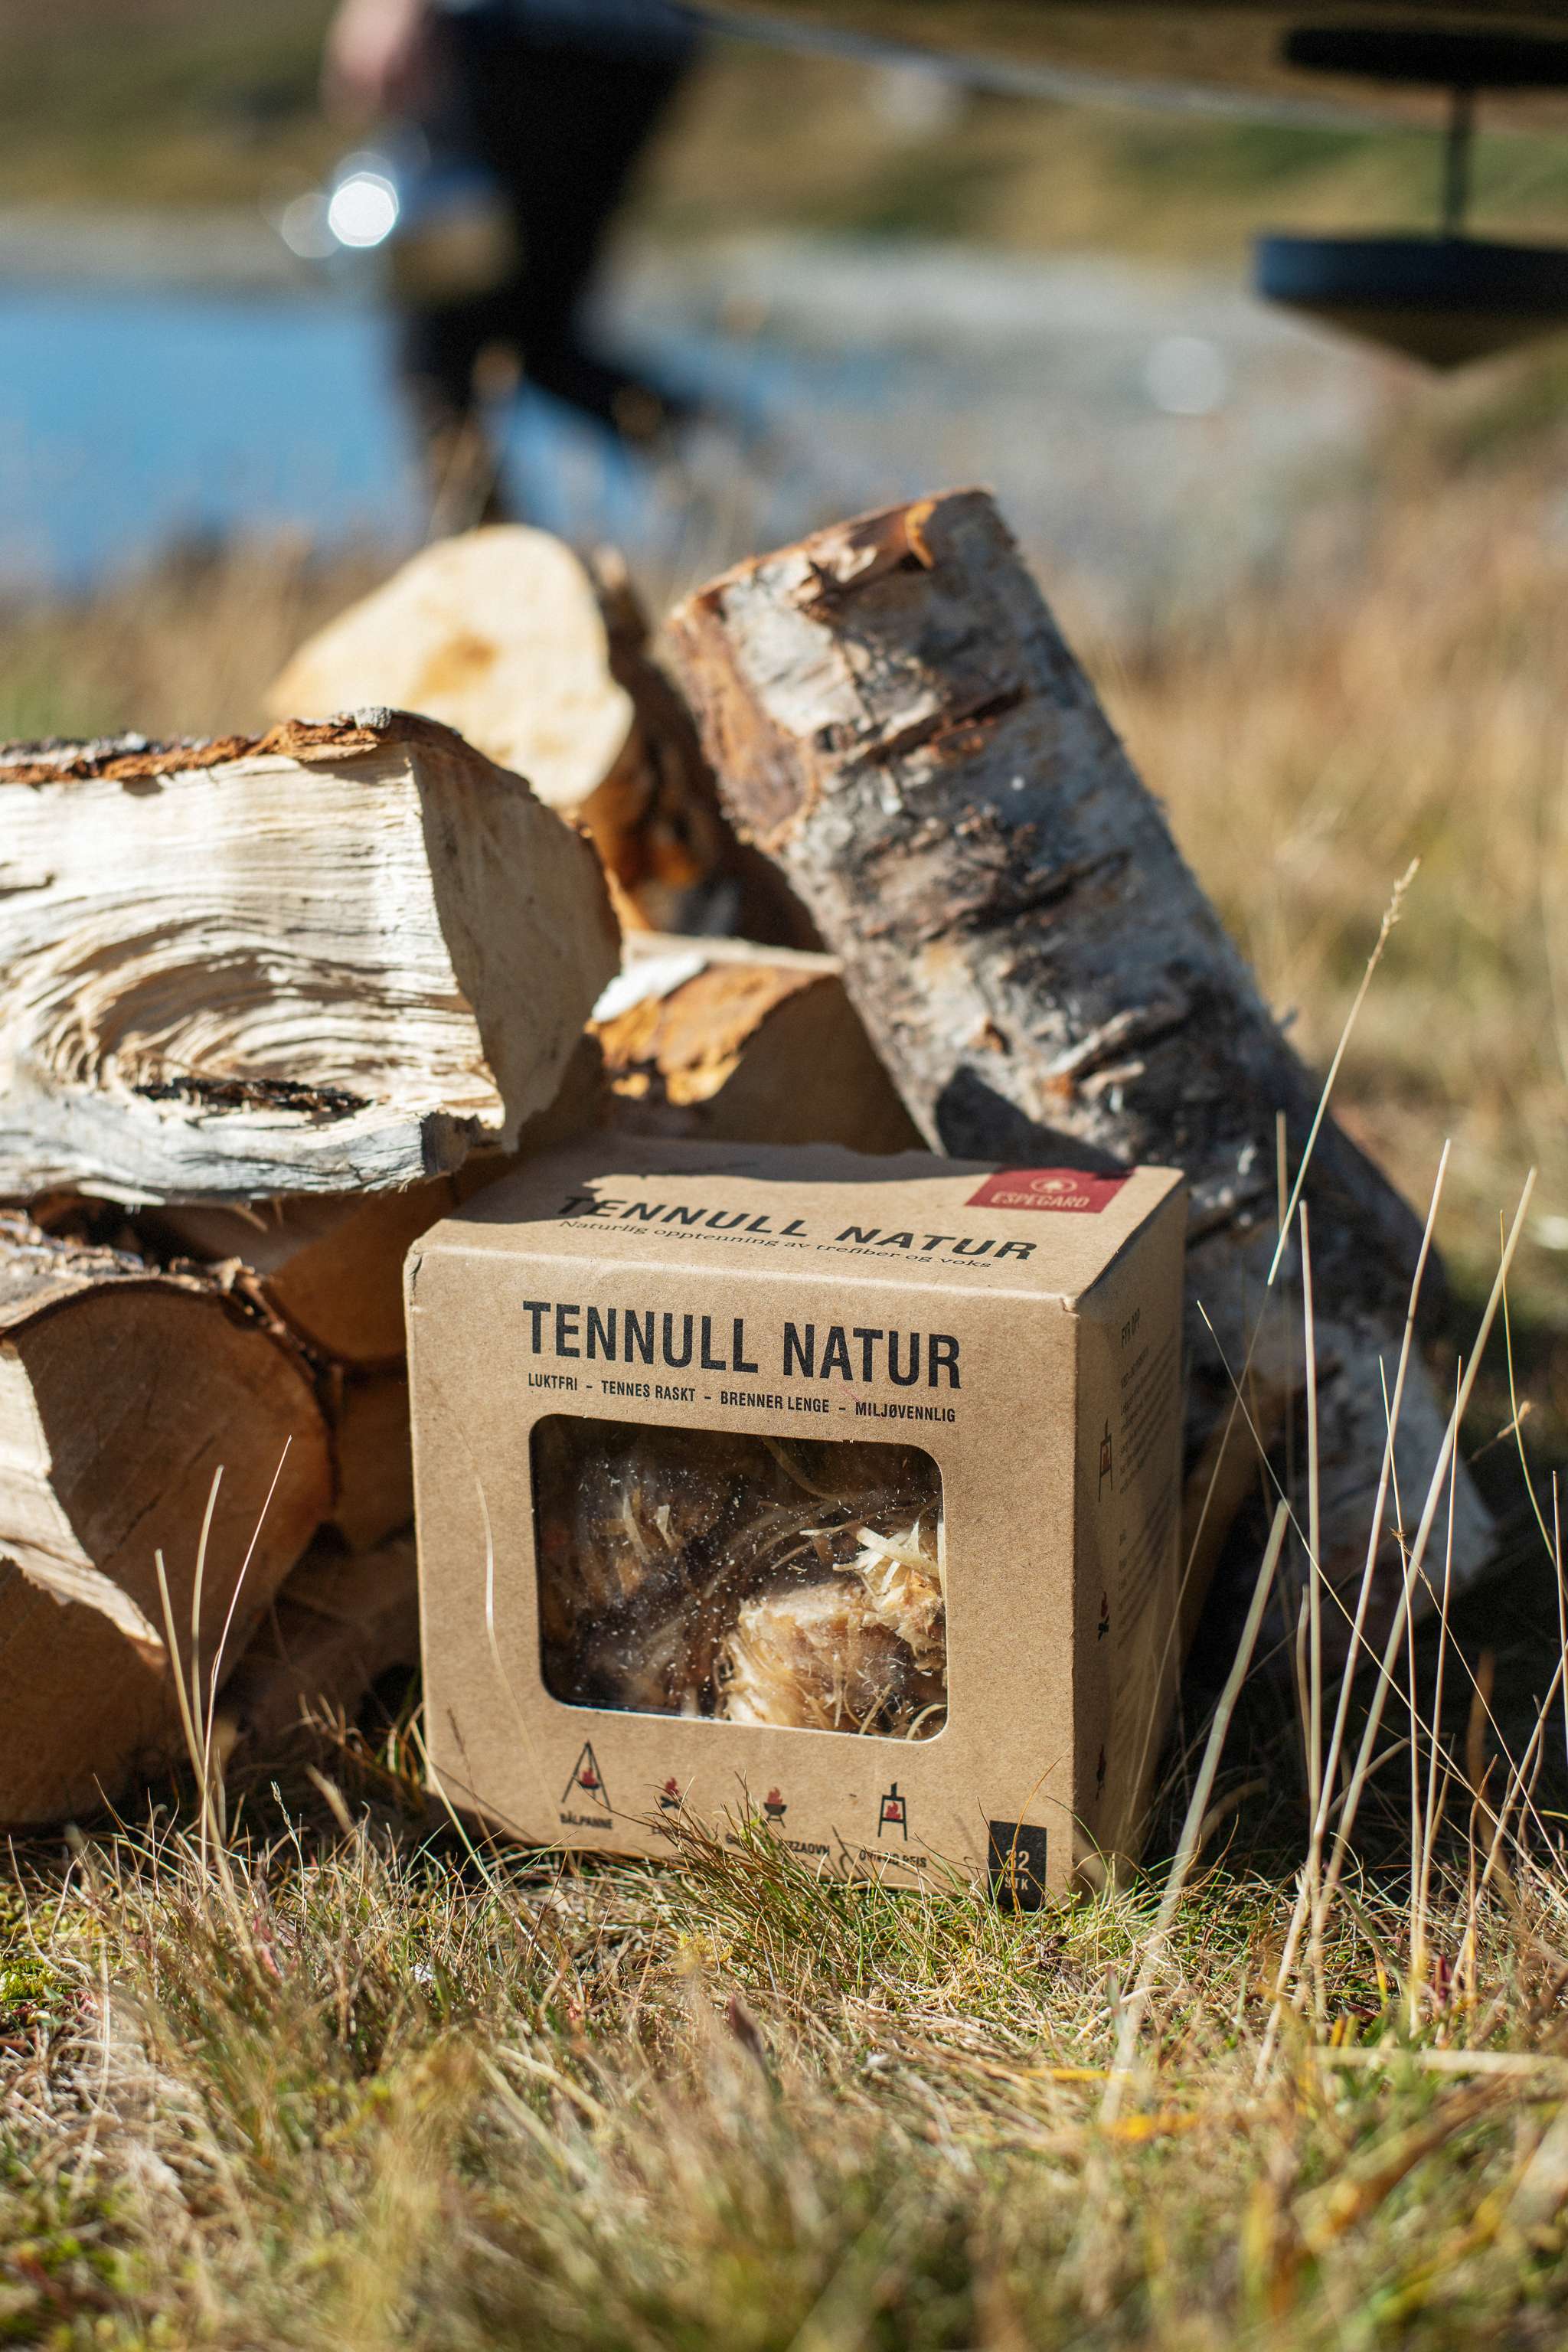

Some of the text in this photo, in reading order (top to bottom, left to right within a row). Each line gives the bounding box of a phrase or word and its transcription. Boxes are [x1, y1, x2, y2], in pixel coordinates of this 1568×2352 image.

[991, 1191, 1090, 1208] ESPEGARD
[557, 1196, 1037, 1260] TENNULL NATUR
[560, 1220, 992, 1269] Naturlig opptenning av trefiber og voks
[523, 1301, 962, 1390] TENNULL NATUR
[528, 1373, 578, 1391] LUKTFRI
[601, 1380, 651, 1399] TENNES
[655, 1386, 696, 1403] RASKT
[720, 1391, 784, 1410] BRENNER
[788, 1396, 830, 1413] LENGE
[855, 1402, 956, 1423] MILJØVENNLIG
